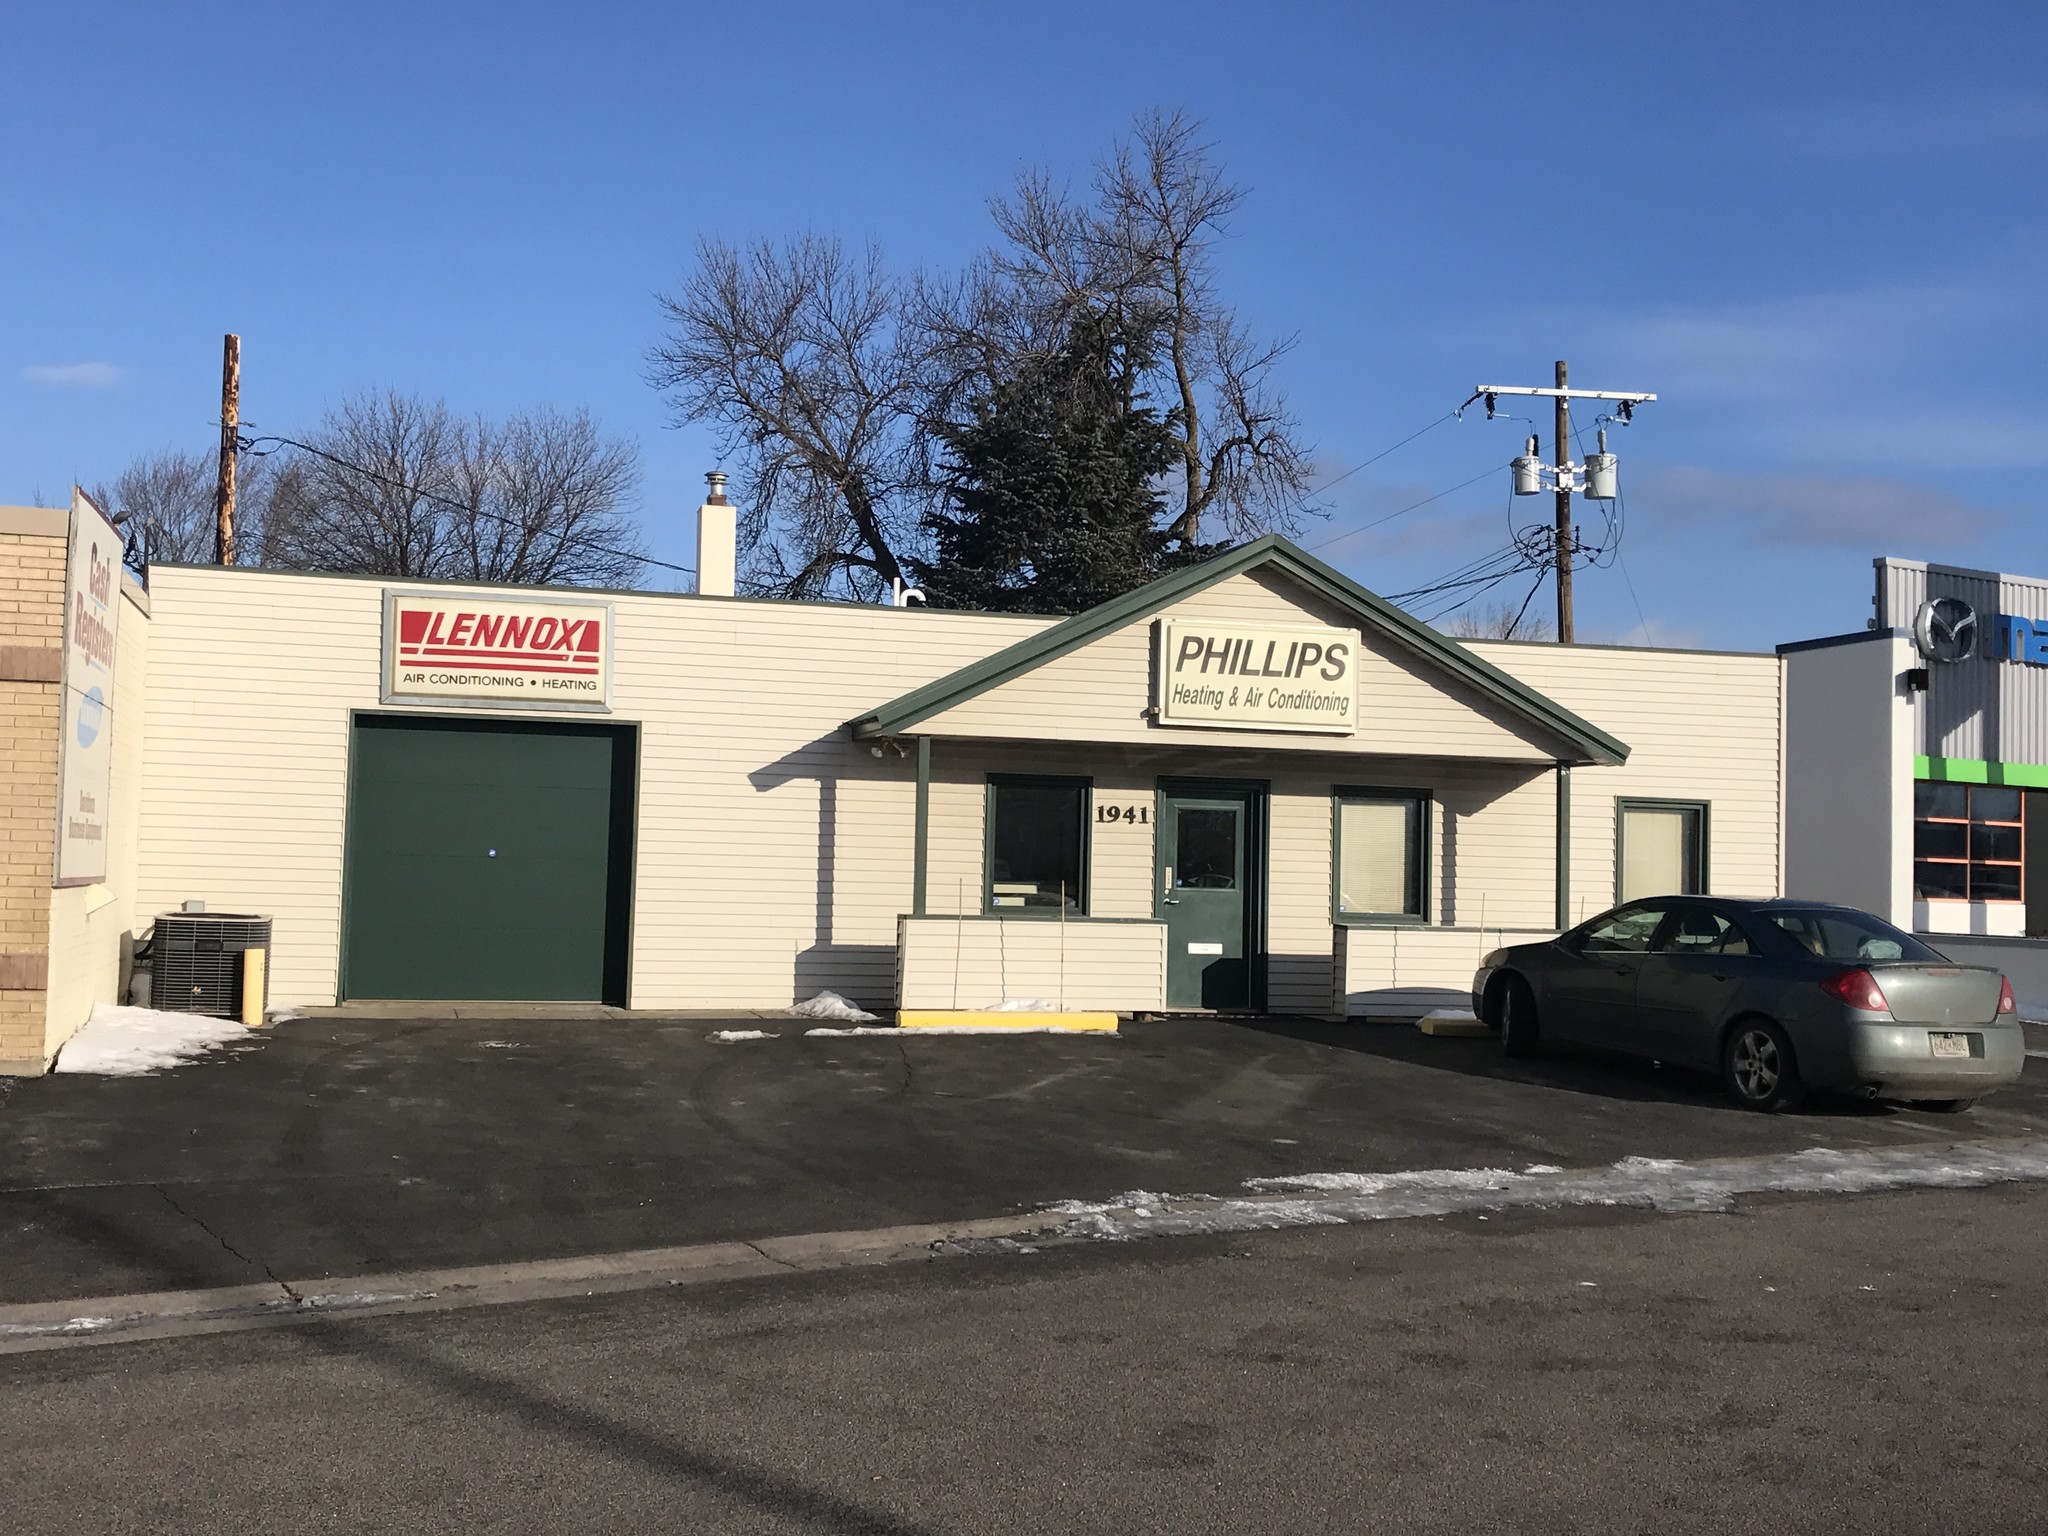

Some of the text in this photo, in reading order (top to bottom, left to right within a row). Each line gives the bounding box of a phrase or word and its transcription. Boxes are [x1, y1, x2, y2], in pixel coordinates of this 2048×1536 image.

[89, 541, 111, 608] Cash
[74, 591, 114, 670] Registers
[426, 612, 587, 651] LENNOX
[1175, 635, 1349, 682] PHILLIPS
[403, 673, 597, 691] AIR CONDITIONING HEATING
[1172, 683, 1350, 717] Heating & Air Conditioning
[1095, 805, 1149, 824] 1941
